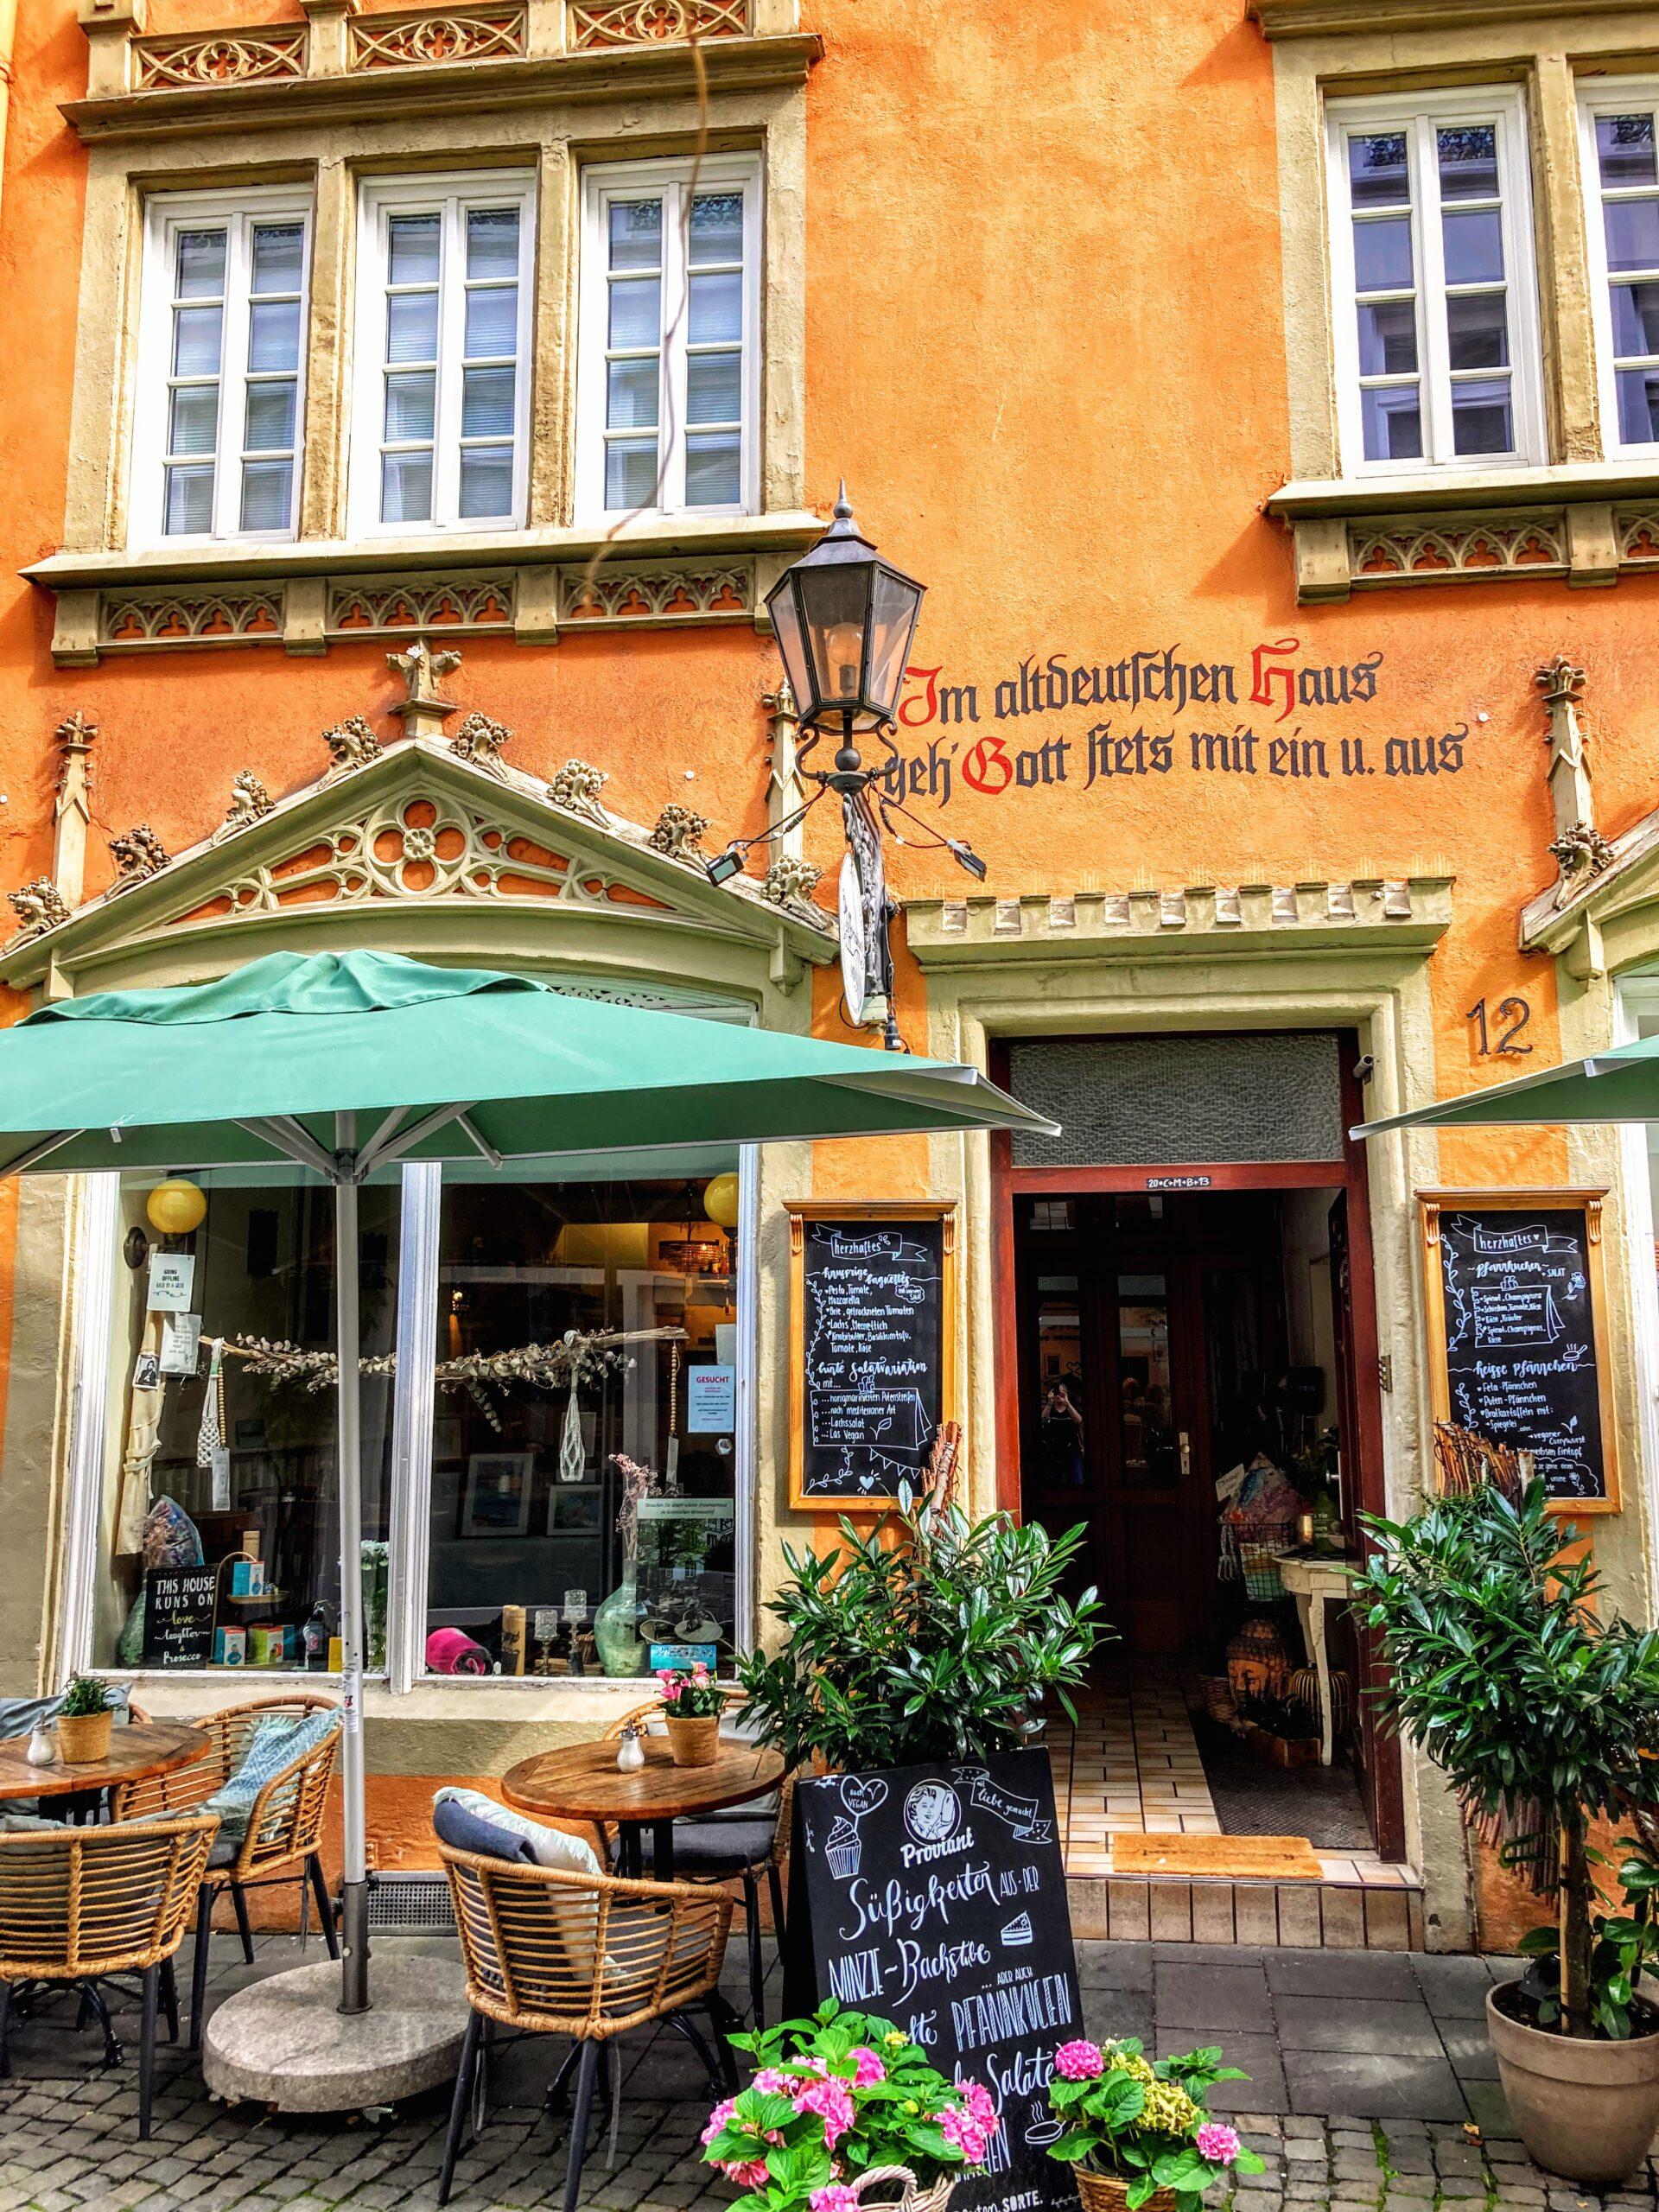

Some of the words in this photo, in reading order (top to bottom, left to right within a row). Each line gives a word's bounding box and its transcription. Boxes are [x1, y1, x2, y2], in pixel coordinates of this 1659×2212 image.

[899, 666, 981, 727] Im
[1249, 638, 1384, 724] Haus
[961, 734, 1071, 795] Gott
[1189, 725, 1261, 777] mit
[1268, 722, 1329, 779] ein
[1340, 740, 1376, 778] u.
[1383, 721, 1471, 779] aus
[1465, 996, 1533, 1056] 12
[835, 1237, 881, 1255] herzhaftes
[1479, 1234, 1532, 1249] herzhaftes
[1547, 1267, 1567, 1277] SALAT
[843, 1429, 865, 1444] Vegan
[156, 1579, 179, 1595] THIS
[181, 1576, 216, 1593] HOUSE
[156, 1594, 189, 1610] RUNS
[198, 1592, 214, 1605] ON
[164, 1627, 200, 1644] laughter
[162, 1650, 202, 1664] Prosecco
[848, 1798, 868, 1809] VEGAN
[1002, 1804, 1033, 1819] gemacht
[899, 1826, 976, 1869] Proviant
[839, 1860, 1001, 1942] Süßigkeiten
[1022, 1865, 1040, 1893] DER
[997, 1969, 1014, 1986] ABER
[1014, 1966, 1033, 1981] AUCH
[986, 2046, 1056, 2117] Salate
